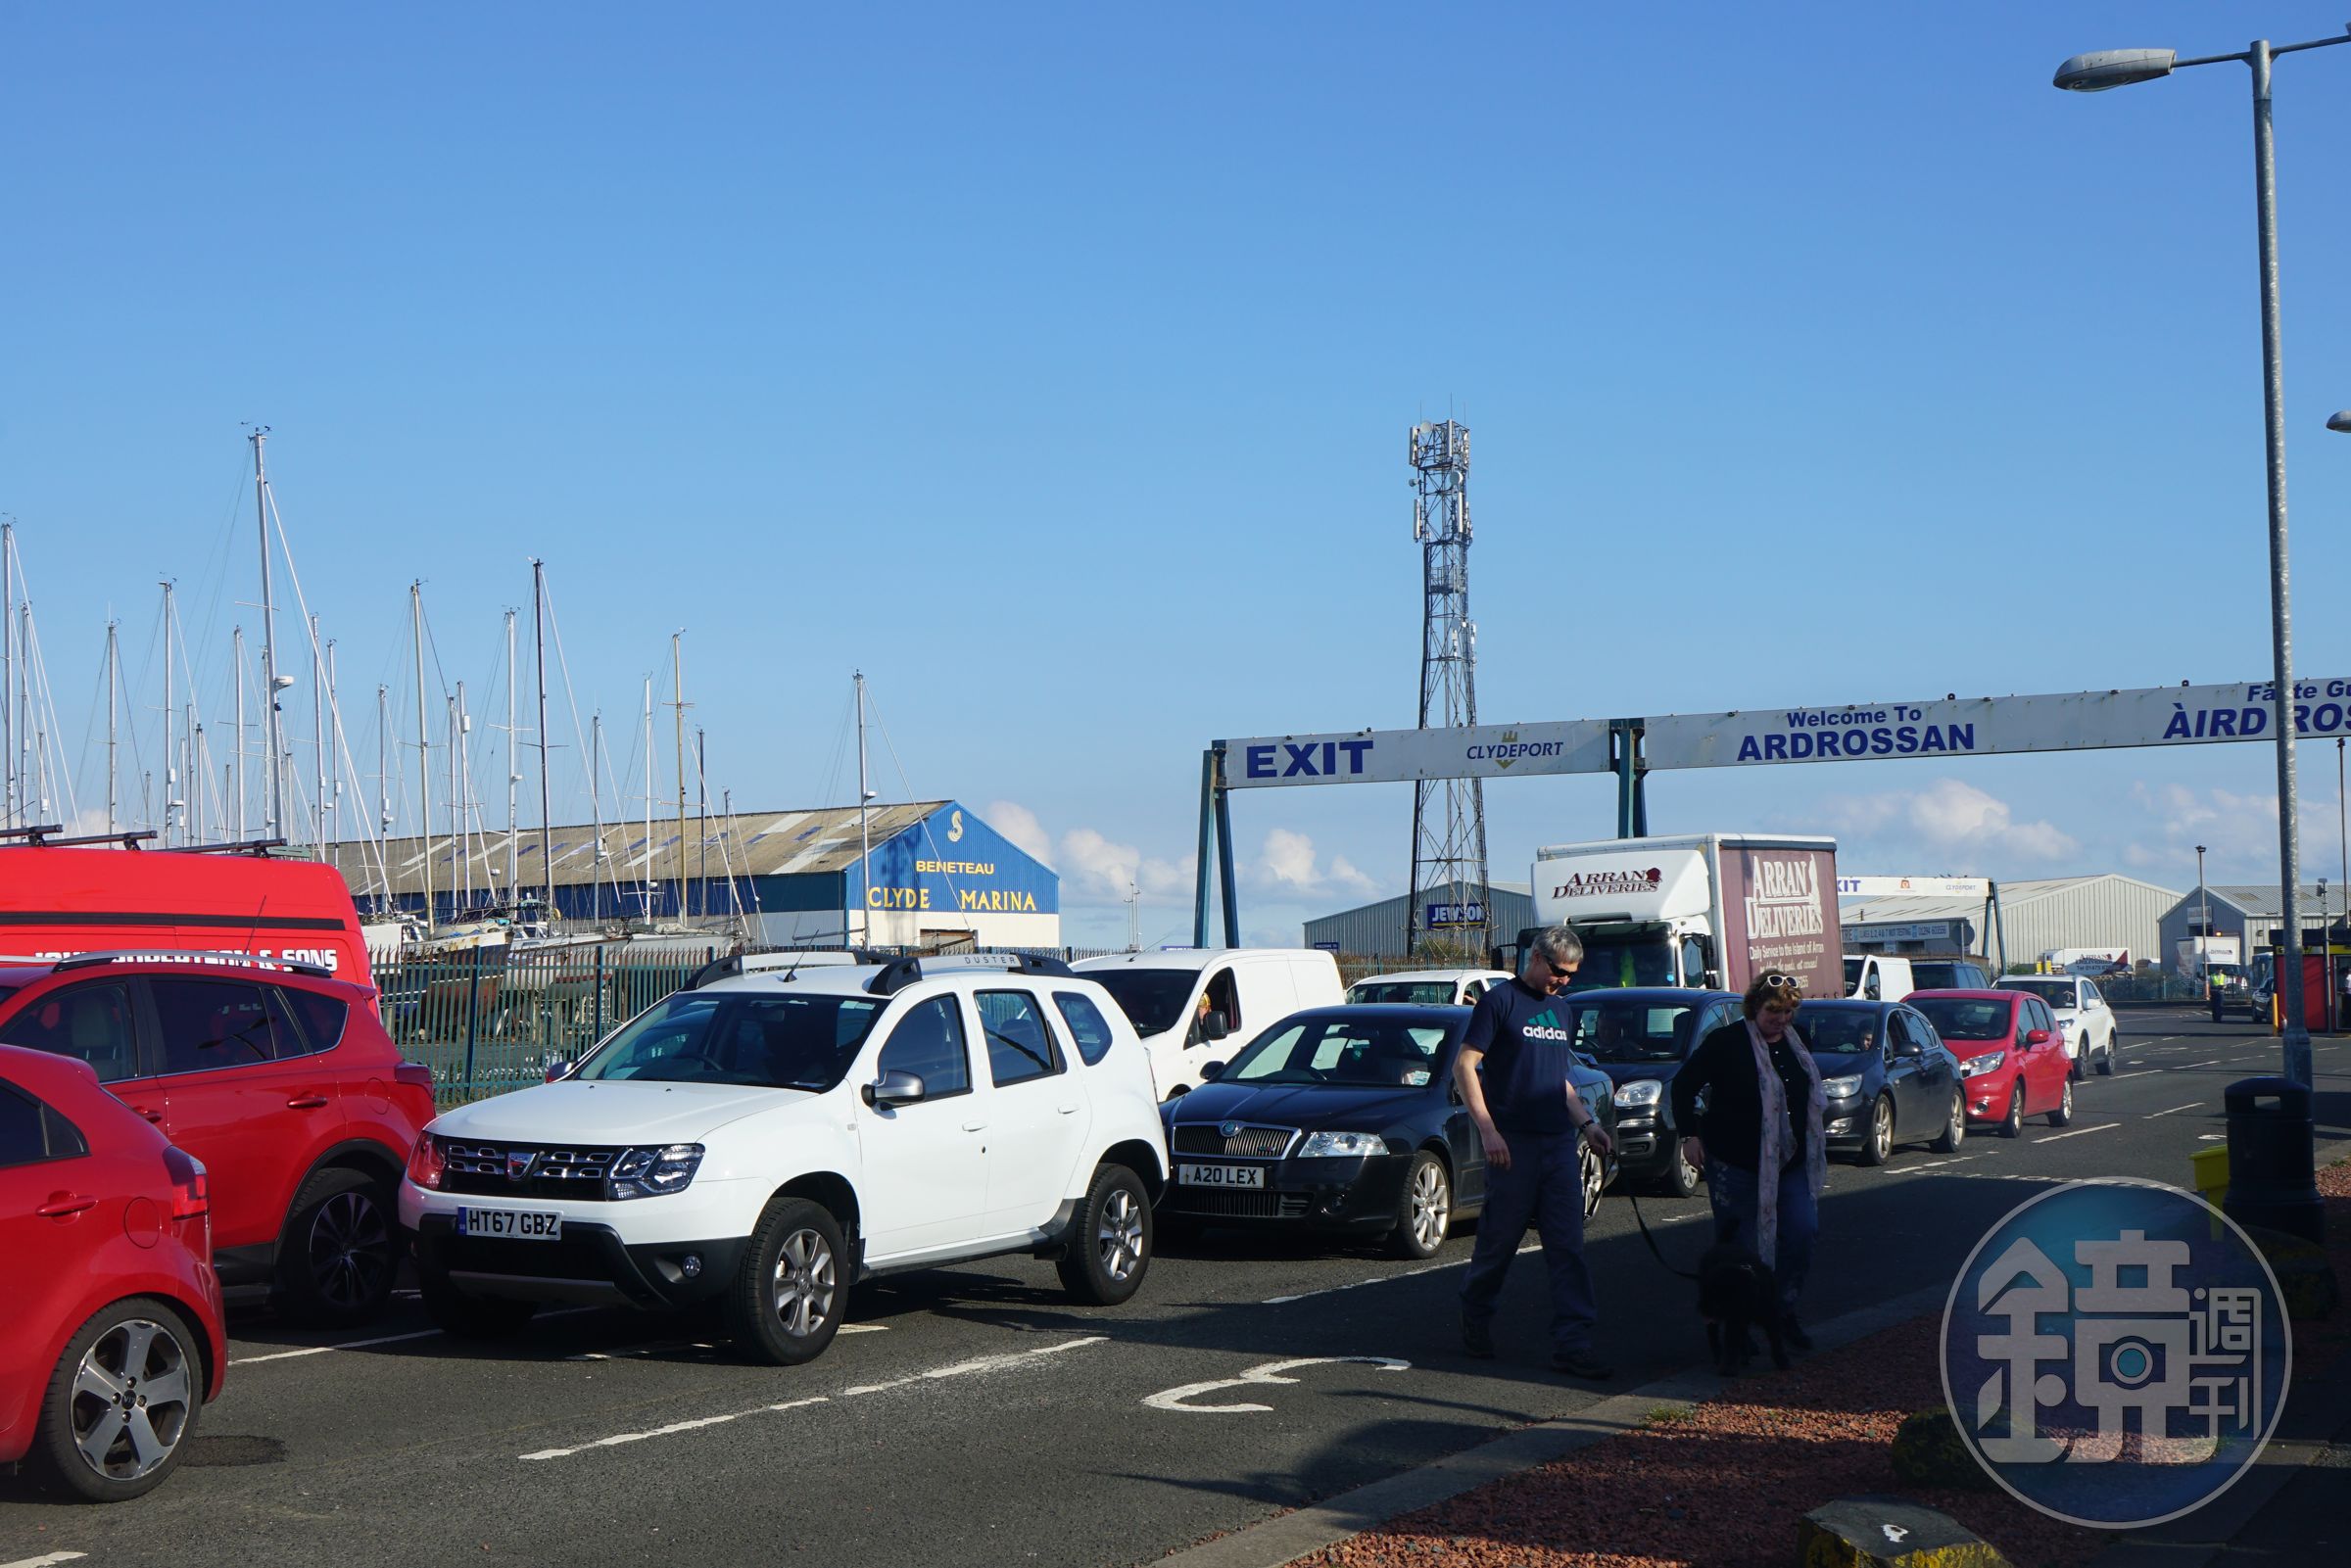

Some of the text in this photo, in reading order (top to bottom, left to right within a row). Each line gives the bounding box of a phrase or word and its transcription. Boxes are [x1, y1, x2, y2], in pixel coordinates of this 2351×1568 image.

[1786, 706, 1923, 729] Welcome To
[2162, 702, 2268, 739] ÀIRD
[1466, 741, 1564, 760] CLYDEPORT
[1737, 723, 1975, 762] ARDROSSAN
[1246, 740, 1373, 779] EXIT
[916, 860, 995, 875] BENETEAU
[1565, 869, 1648, 887] ARRAN
[1752, 855, 1807, 902] ARRAN
[868, 886, 1037, 911] CLYDE MARINA
[1552, 881, 1658, 900] DELIVERIES
[1745, 896, 1823, 939] DELIVERIES
[964, 956, 1016, 965] DUSTER
[1749, 945, 1762, 962] Daily
[1762, 944, 1779, 958] Service
[1779, 944, 1784, 956] to
[1793, 941, 1806, 955] Island
[1806, 941, 1812, 954] of
[1522, 1025, 1567, 1041] adidas
[1193, 1166, 1257, 1185] A20 LEX
[468, 1210, 557, 1236] HT67 GBZ
